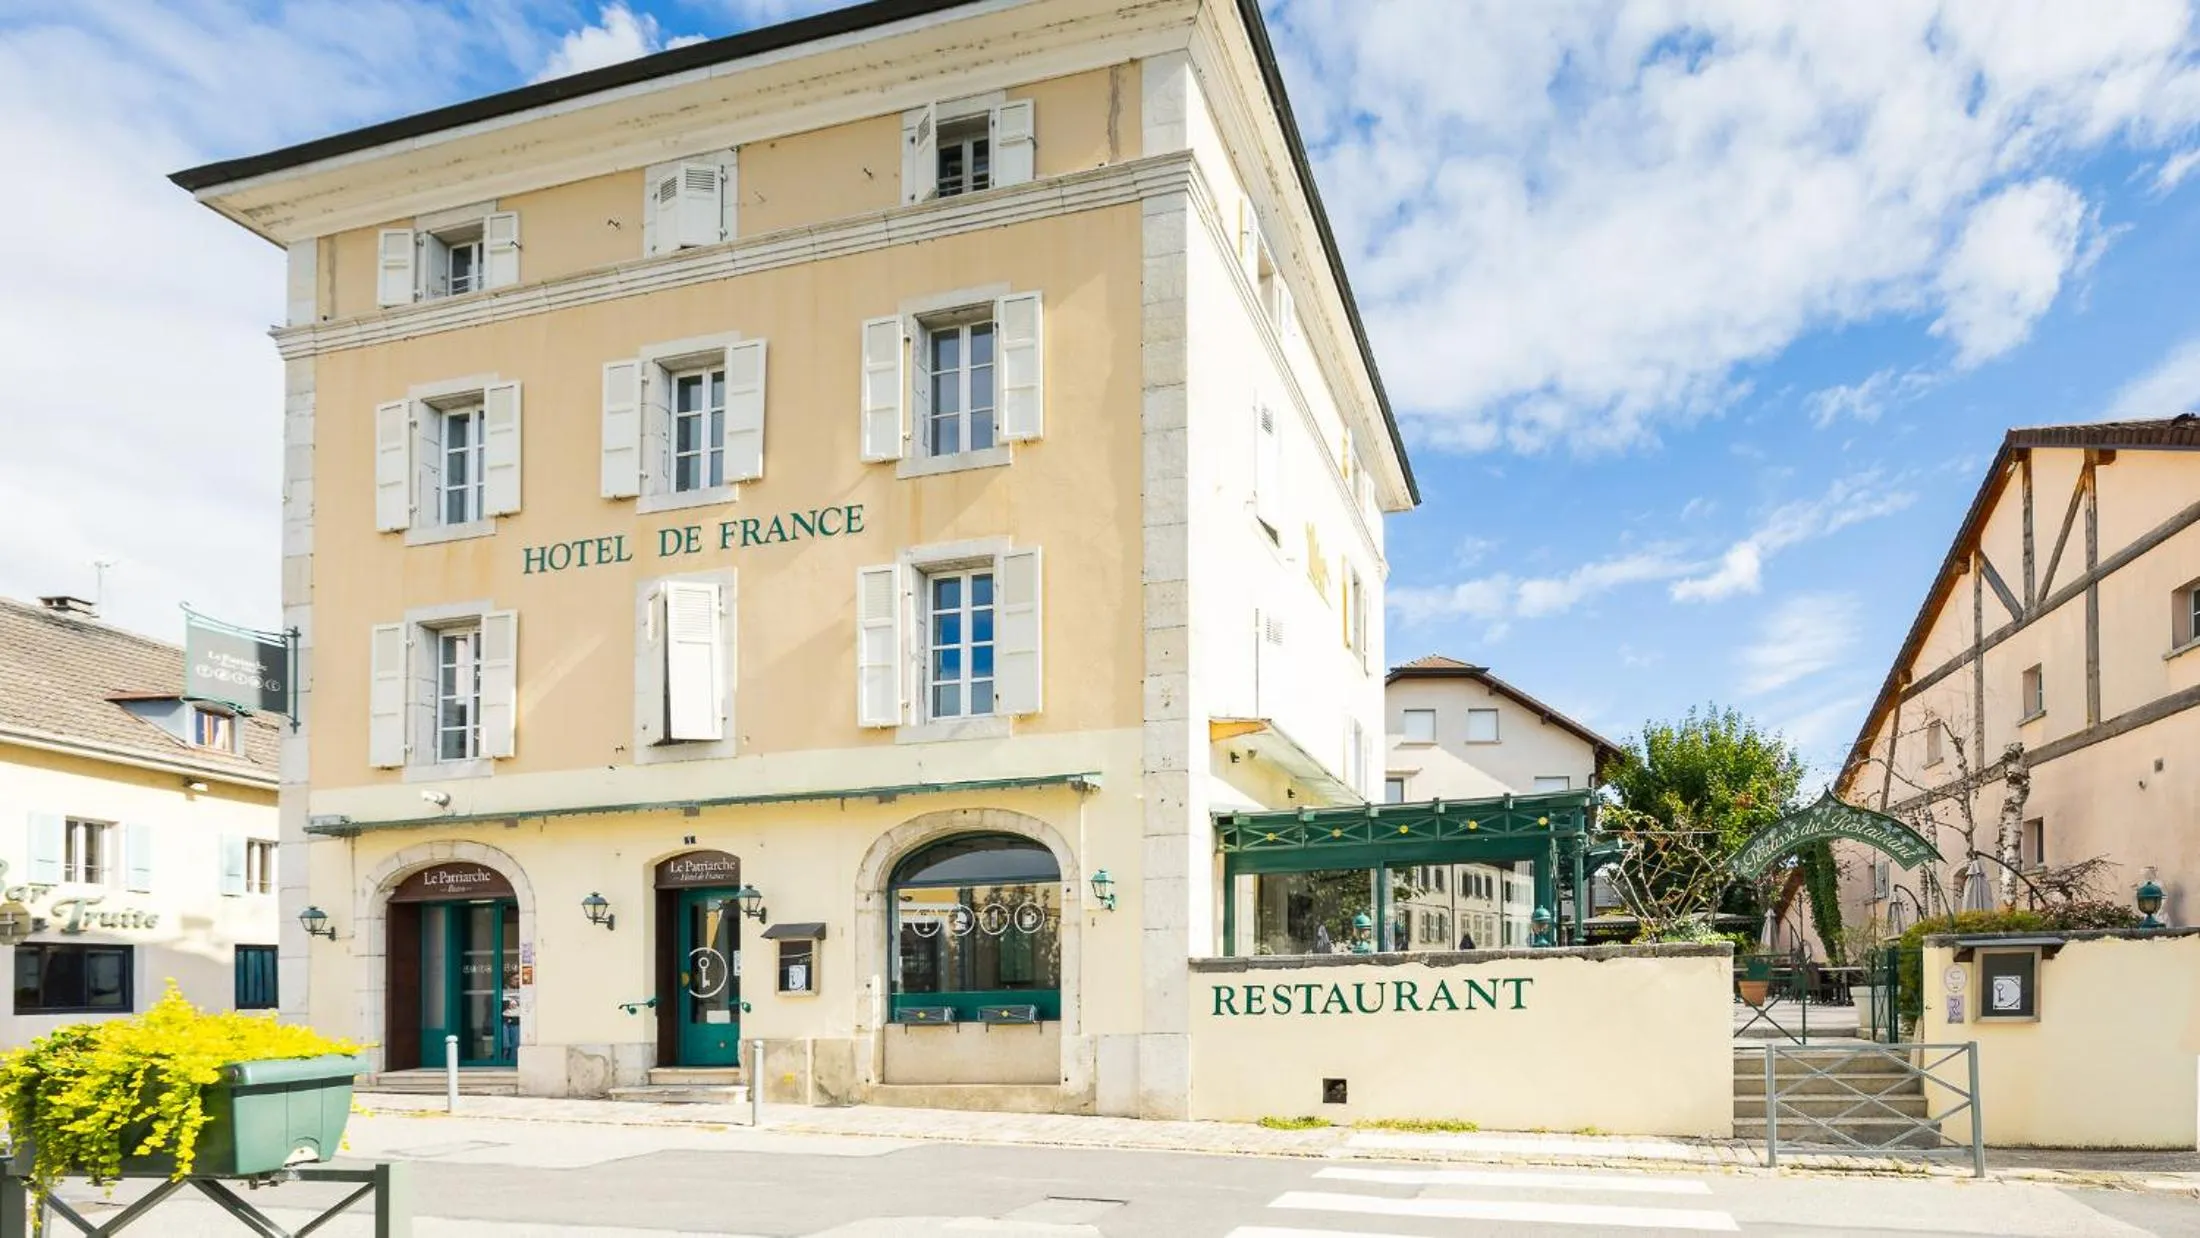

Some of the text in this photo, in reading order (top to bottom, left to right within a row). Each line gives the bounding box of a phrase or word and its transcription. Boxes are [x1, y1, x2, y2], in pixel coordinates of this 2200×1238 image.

[523, 504, 865, 574] HOTEL DE FRANCE
[1801, 818, 1821, 835] du
[1824, 814, 1917, 859] Restaurant
[423, 868, 491, 885] Le Patriarche
[670, 857, 736, 873] Le Patriarche
[1211, 977, 1534, 1016] RESTAURANT
